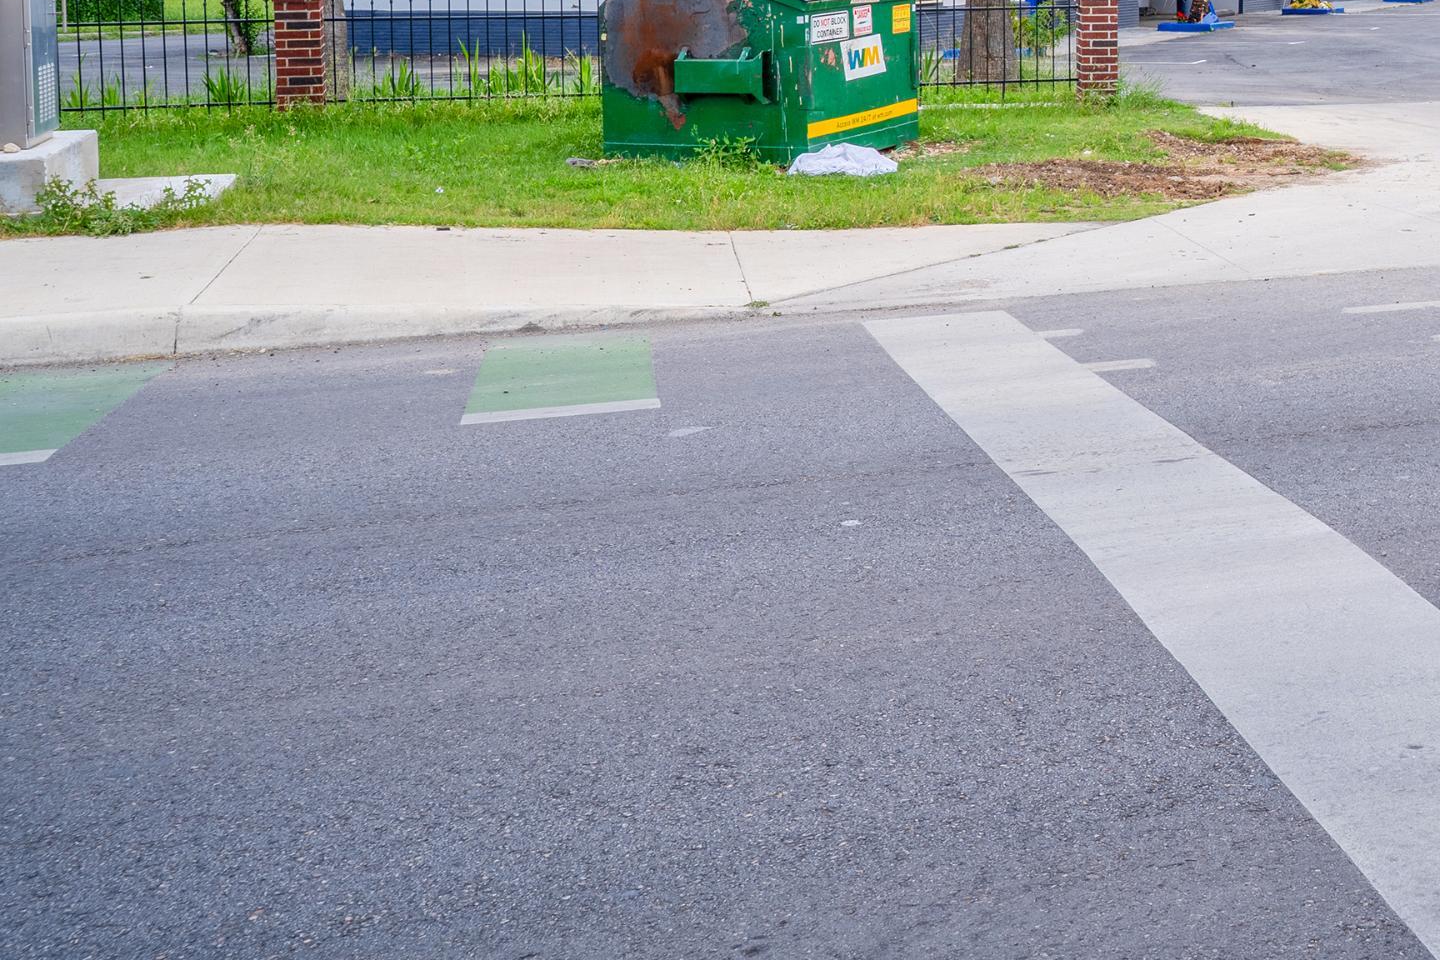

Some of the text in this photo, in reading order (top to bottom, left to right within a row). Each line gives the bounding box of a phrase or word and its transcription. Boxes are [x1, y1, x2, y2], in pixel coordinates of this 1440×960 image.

[813, 16, 847, 28] DO NOT BLOCK
[817, 27, 843, 38] CONTAINER
[848, 45, 880, 70] WM
